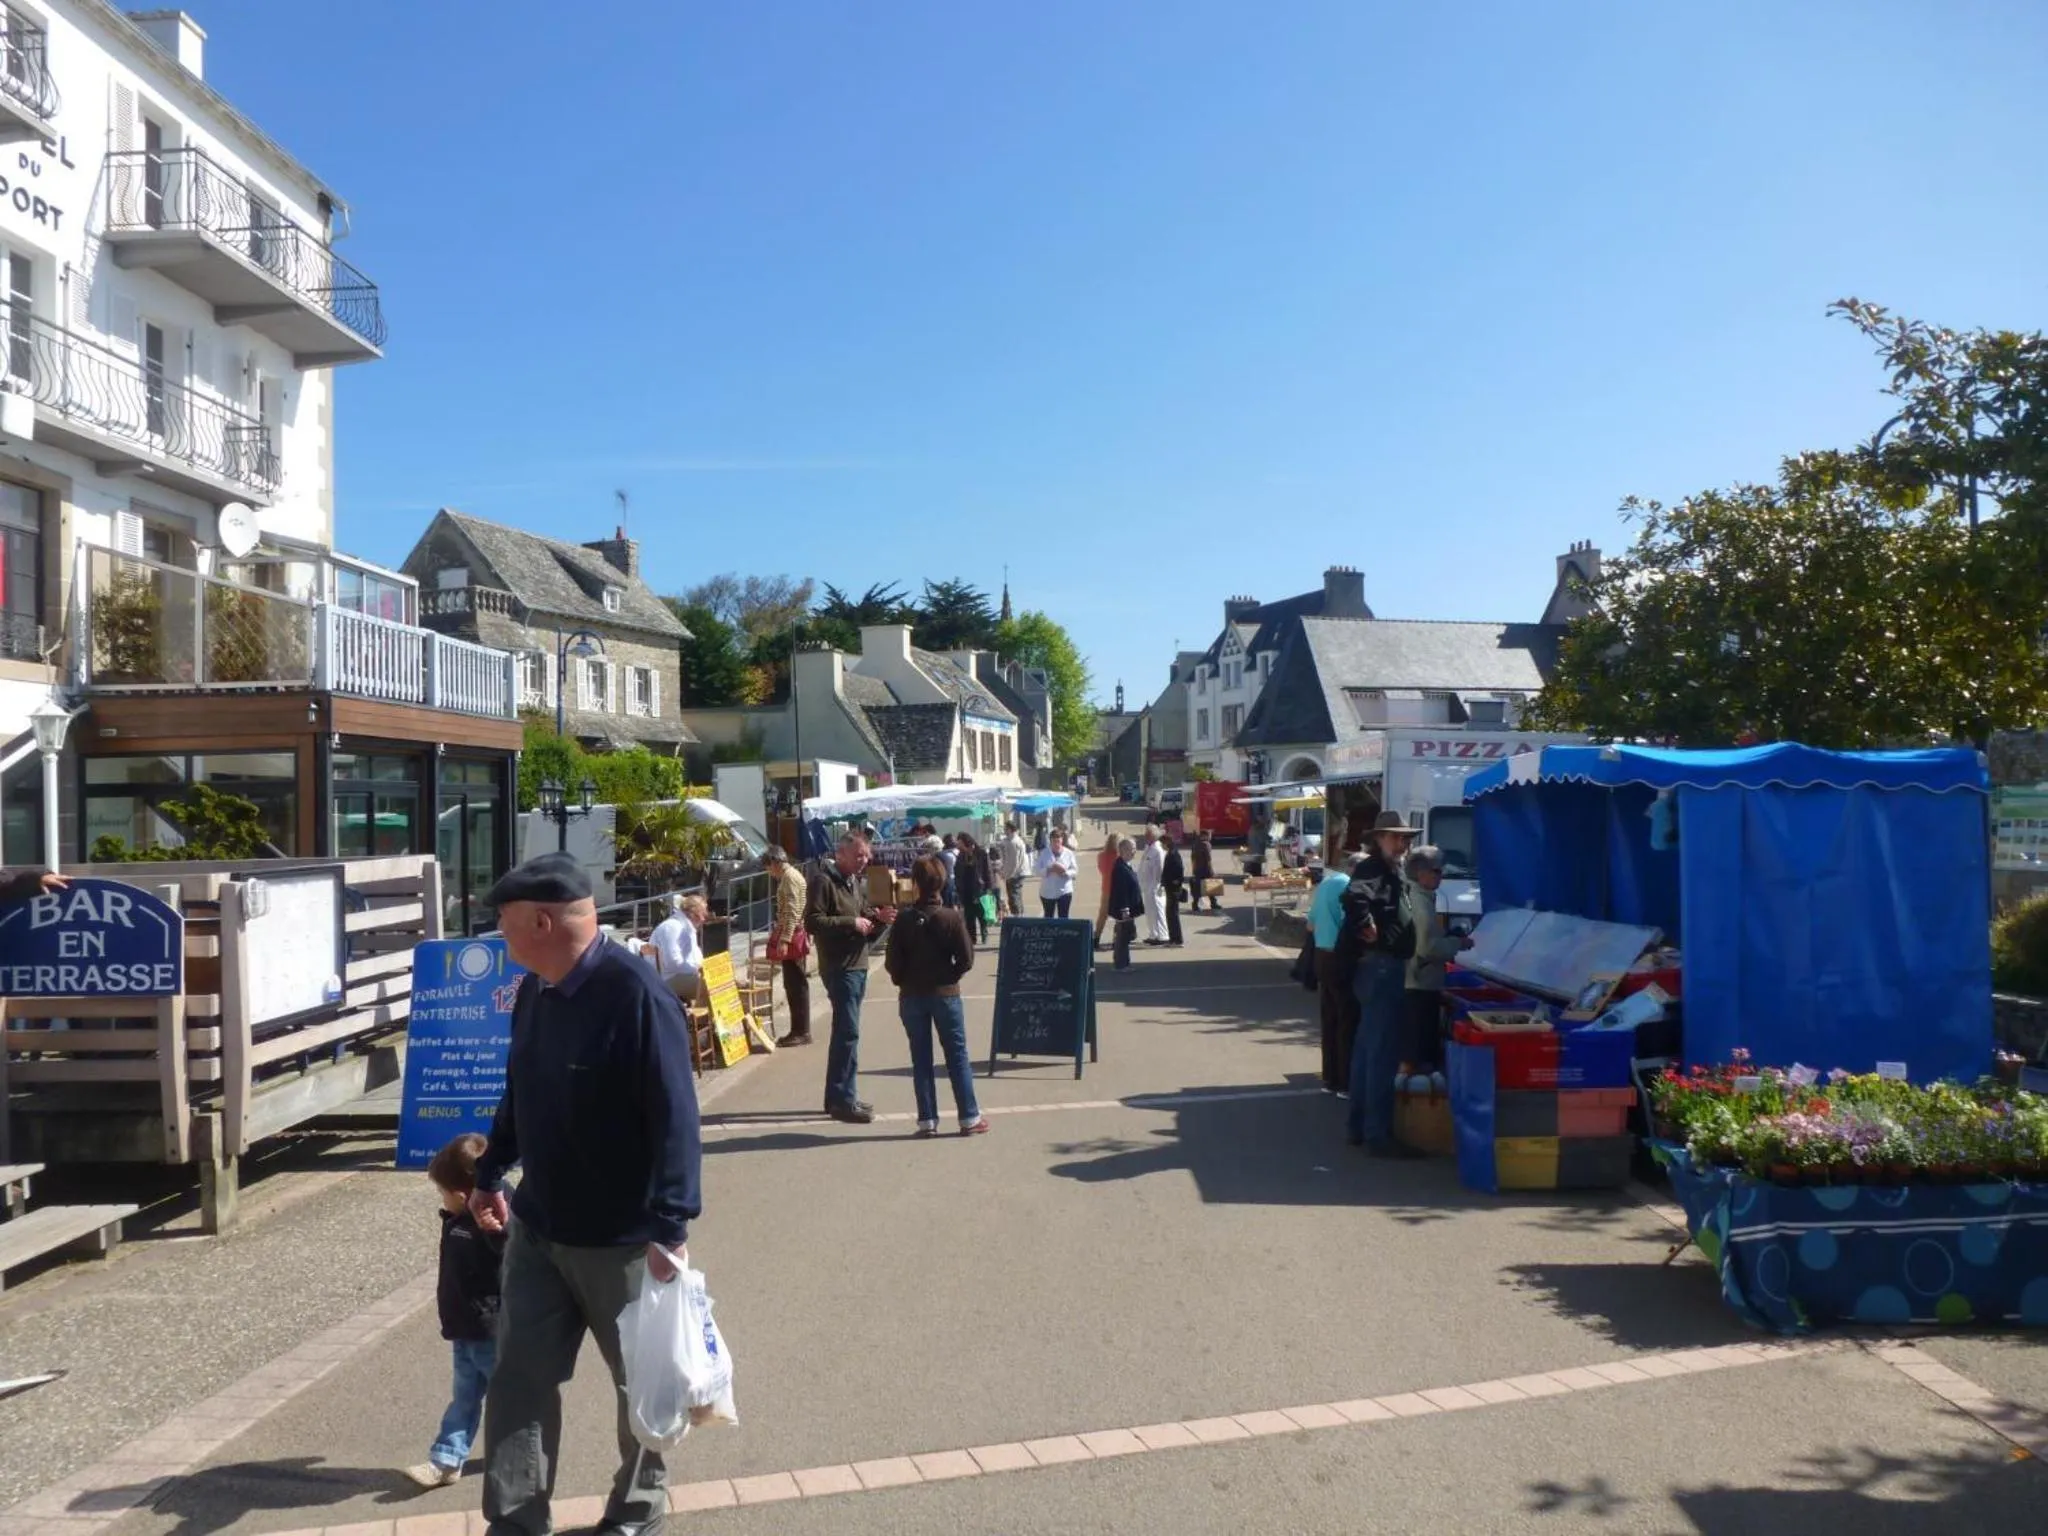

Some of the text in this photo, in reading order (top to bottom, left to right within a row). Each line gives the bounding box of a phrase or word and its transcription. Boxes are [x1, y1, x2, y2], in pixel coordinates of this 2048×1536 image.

[18, 152, 41, 177] DU
[29, 888, 135, 929] BAR
[58, 930, 106, 957] EN
[414, 983, 472, 1002] FORMULE
[412, 1005, 487, 1021] ENTREPRISE
[441, 1052, 461, 1061] Plat
[472, 1081, 507, 1092] compri
[418, 1106, 498, 1118] MENUS CAR
